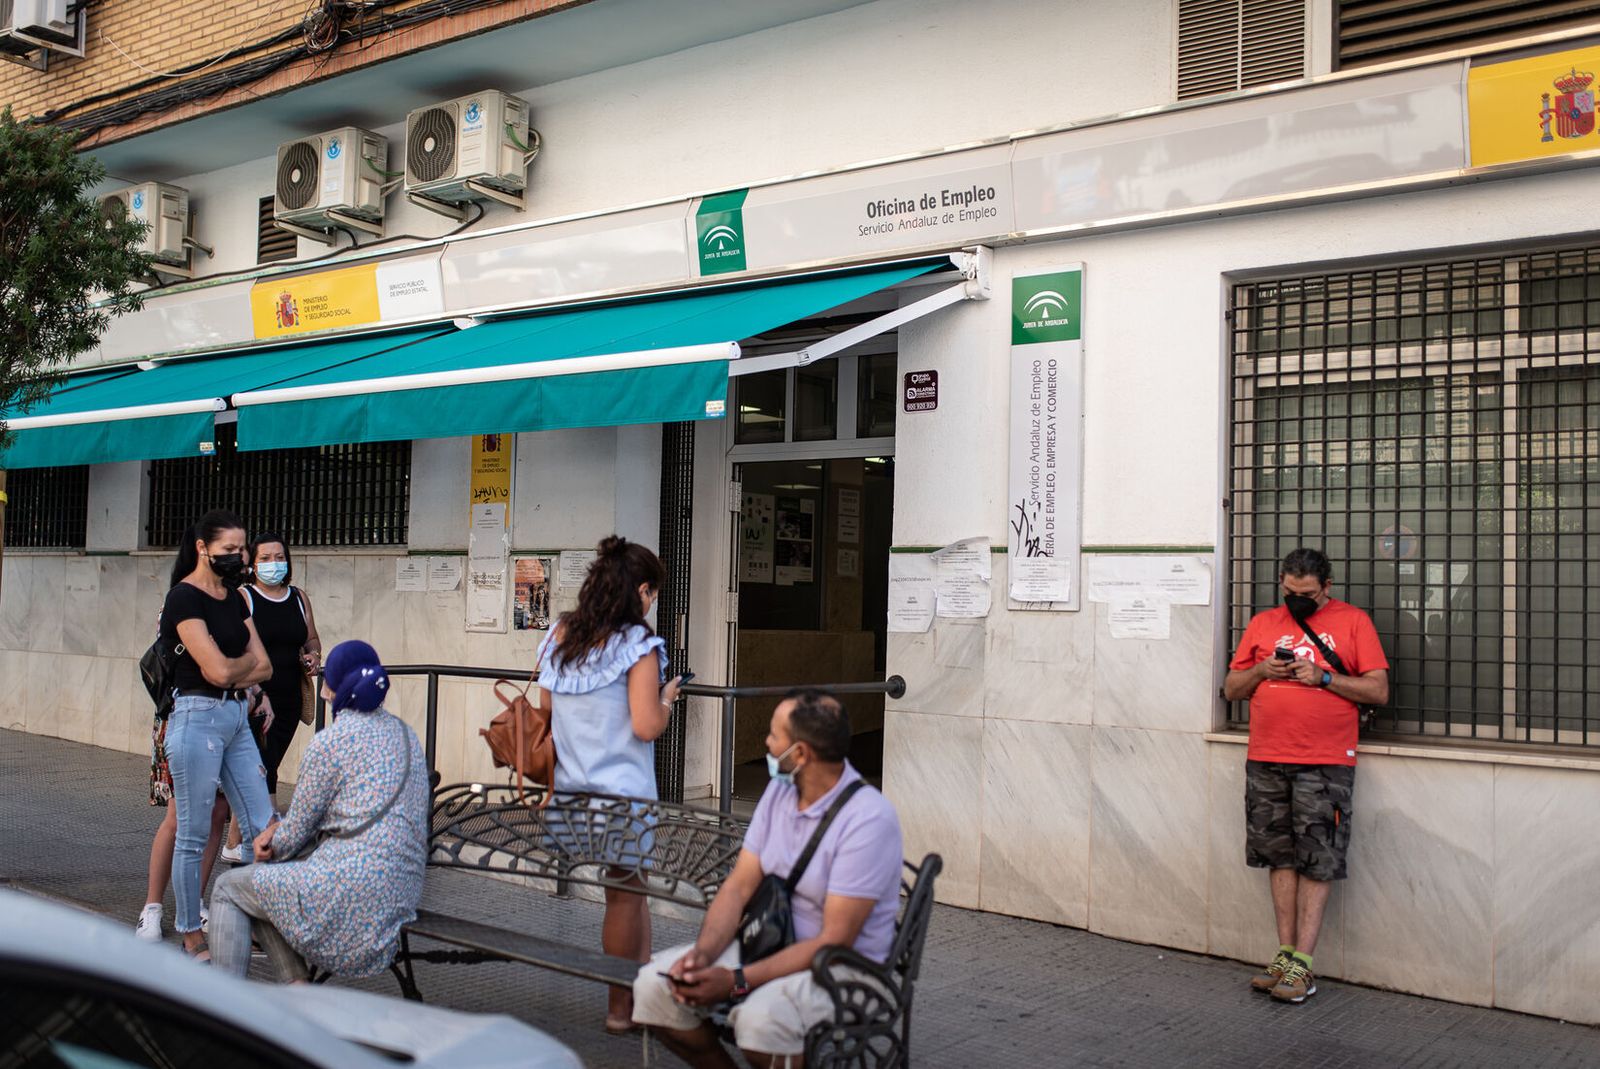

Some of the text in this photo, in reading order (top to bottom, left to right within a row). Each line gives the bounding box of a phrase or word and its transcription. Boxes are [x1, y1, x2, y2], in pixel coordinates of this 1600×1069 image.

[867, 185, 996, 219] Oficina de Empleo
[858, 206, 997, 237] Servicio Andaluz de Empleo
[303, 295, 328, 304] MINISTERIO
[304, 303, 329, 313] DE EMPLEO
[309, 311, 334, 320] SEGURIDAD
[334, 308, 352, 316] SOCIAL
[1047, 359, 1057, 413] COMERCIO
[1029, 360, 1043, 506] Servicio Andaluz de Empleo
[1046, 422, 1057, 469] EMPRESA
[1045, 471, 1057, 514] EMPLEO,
[1046, 516, 1055, 530] DE
